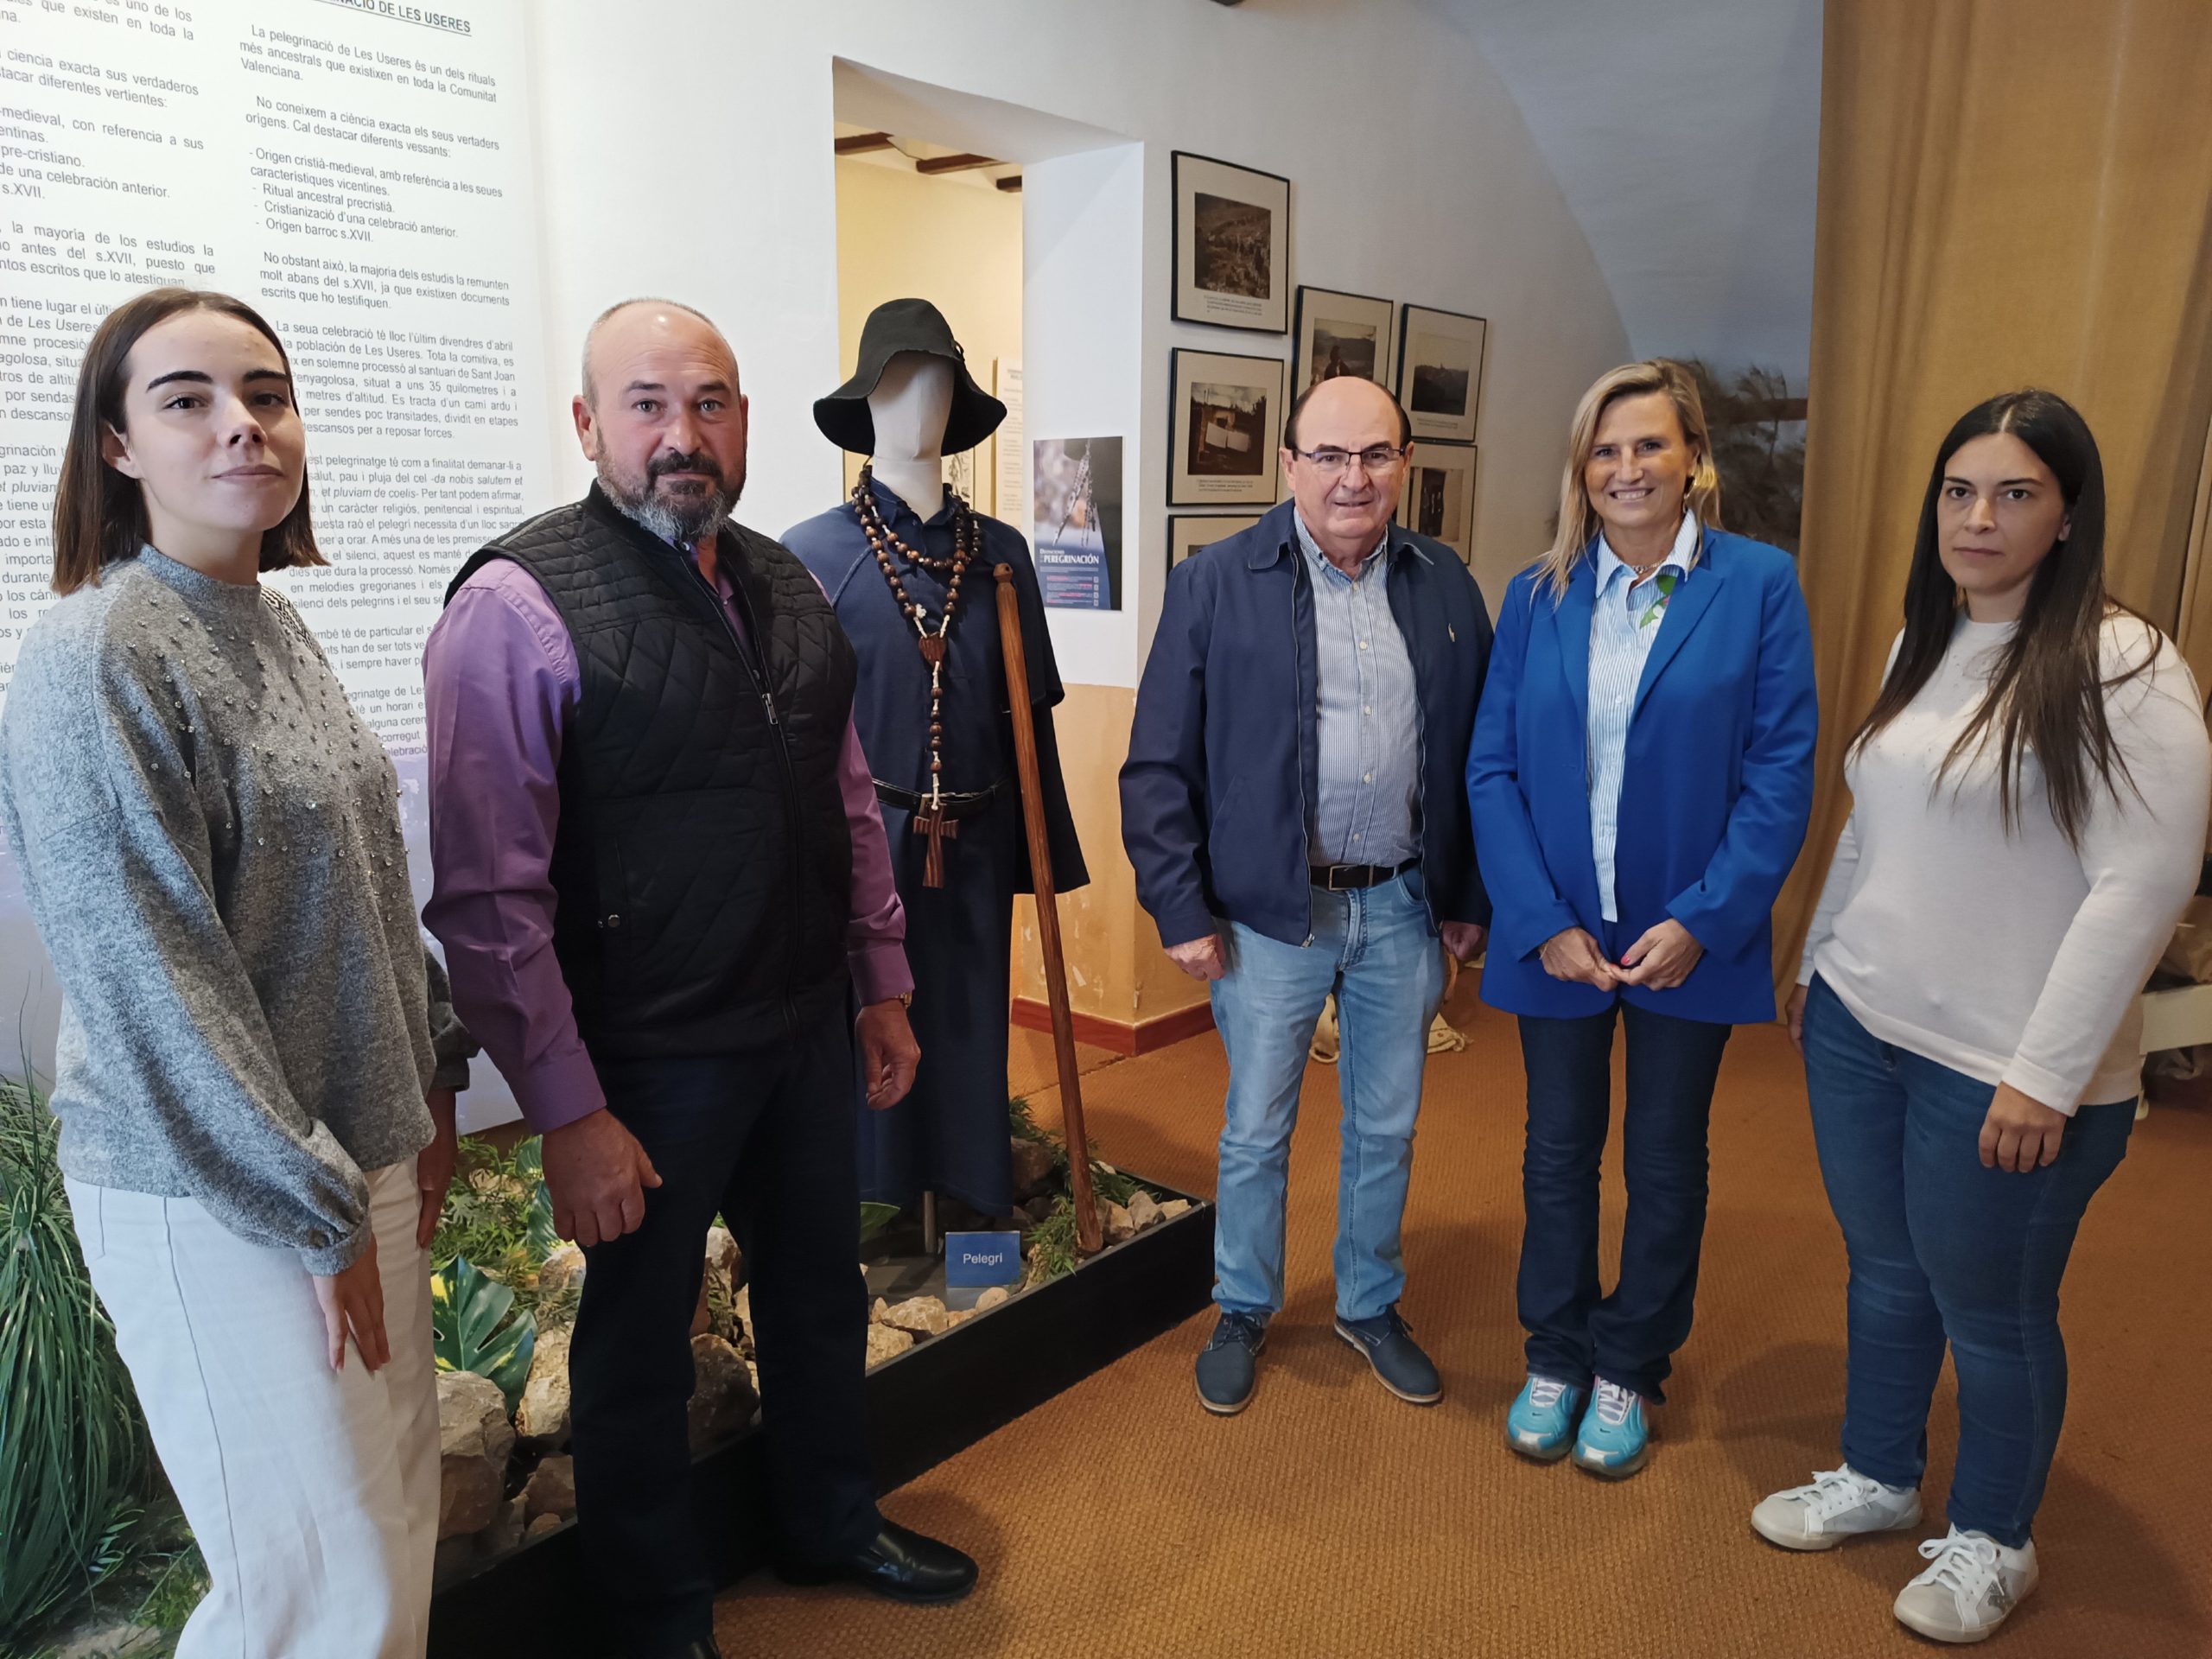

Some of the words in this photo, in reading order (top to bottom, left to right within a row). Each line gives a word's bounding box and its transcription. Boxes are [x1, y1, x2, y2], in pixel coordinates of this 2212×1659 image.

[41, 0, 66, 13] que
[73, 6, 118, 24] existen
[126, 17, 142, 29] en
[149, 21, 175, 37] toda
[183, 27, 194, 41] la
[125, 0, 149, 12] uno
[154, 3, 169, 17] de
[175, 7, 193, 22] los
[379, 1, 395, 15] DE
[398, 5, 421, 22] LES
[424, 12, 471, 33] USERES
[251, 24, 265, 38] La
[337, 43, 351, 56] de
[354, 46, 373, 61] Les
[376, 51, 412, 69] Useres
[429, 65, 442, 75] un
[445, 67, 465, 80] dels
[467, 72, 496, 86] rituals
[7, 48, 54, 68] ciencia
[59, 60, 100, 77] exacta
[105, 69, 128, 82] sus
[132, 75, 199, 96] verdaderos
[239, 41, 263, 55] més
[267, 48, 322, 67] ancestrals
[326, 60, 346, 72] que
[349, 64, 393, 82] existixen
[397, 74, 410, 85] en
[413, 76, 435, 90] toda
[437, 80, 447, 92] la
[449, 83, 497, 103] Comunitat
[241, 57, 303, 80] Valenciana.
[38, 73, 102, 96] diferentes
[105, 88, 168, 108] vertientes:
[73, 119, 95, 131] con
[102, 124, 162, 143] referencia
[169, 136, 177, 145] a
[183, 138, 204, 149] sus
[257, 95, 272, 110] No
[276, 101, 327, 119] coneixem
[330, 111, 337, 121] a
[378, 121, 411, 135] exacta
[414, 125, 429, 138] els
[431, 130, 454, 143] seus
[456, 135, 499, 150] vertaders
[293, 119, 311, 133] Cal
[314, 124, 358, 142] destacar
[360, 132, 404, 149] diferents
[406, 142, 451, 158] vessants:
[0, 145, 85, 168] pre-cristiano.
[18, 168, 42, 180] una
[47, 171, 118, 191] celebración
[122, 182, 170, 198] anterior.
[256, 147, 292, 165] Origen
[379, 170, 401, 181] amb
[452, 181, 459, 191] a
[460, 181, 474, 194] les
[475, 186, 503, 198] seues
[2, 182, 45, 199] s.XVII.
[263, 182, 294, 198] Ritual
[296, 190, 344, 206] ancestral
[336, 178, 390, 196] vicentines.
[12, 220, 23, 234] la
[95, 232, 111, 245] de
[119, 233, 137, 248] los
[146, 239, 195, 254] estudios
[203, 244, 214, 257] la
[265, 217, 302, 234] Origen
[304, 222, 338, 238] barroc
[340, 228, 373, 242] s.XVII.
[420, 225, 458, 238] anterior.
[21, 243, 57, 257] antes
[67, 246, 86, 260] del
[95, 251, 136, 267] s.XVII,
[145, 257, 185, 270] puesto
[194, 263, 215, 275] que
[264, 251, 280, 264] No
[281, 253, 321, 269] obstant
[349, 262, 359, 273] la
[398, 268, 419, 281] dels
[421, 272, 454, 284] estudis
[456, 274, 465, 286] la
[467, 277, 509, 290] remunten
[30, 263, 80, 277] escritos
[83, 269, 106, 282] que
[110, 269, 121, 282] lo
[260, 269, 283, 282] molt
[287, 271, 320, 285] abans
[323, 275, 340, 288] del
[343, 278, 377, 293] s.XVII,
[381, 281, 390, 295] ja
[393, 285, 412, 296] que
[416, 286, 457, 300] existixen
[461, 291, 510, 306] documents
[261, 287, 296, 300] escrits
[298, 291, 319, 303] que
[321, 291, 335, 303] ho
[10, 296, 42, 310] tiene
[46, 299, 77, 315] lugar
[80, 302, 92, 315] el
[7, 314, 23, 327] de
[28, 315, 51, 330] Les
[55, 318, 99, 333] Useres
[276, 320, 289, 333] La
[293, 324, 319, 335] seua
[389, 330, 406, 342] lloc
[439, 335, 484, 349] divendres
[28, 372, 44, 384] de
[4, 391, 26, 404] por
[30, 391, 75, 404] sendas
[357, 426, 373, 436] per
[376, 427, 383, 435] a
[385, 427, 421, 438] reposar
[3, 464, 28, 477] paz
[31, 466, 39, 478] y
[7, 499, 39, 512] tiene
[338, 502, 378, 514] caràcter
[383, 503, 420, 517] religiós,
[20, 518, 47, 530] esta
[1044, 554, 1099, 564] PEREGRINACIÓN
[290, 584, 304, 594] en
[308, 582, 354, 593] melodies
[359, 580, 416, 594] gregorianes
[429, 579, 442, 589] els
